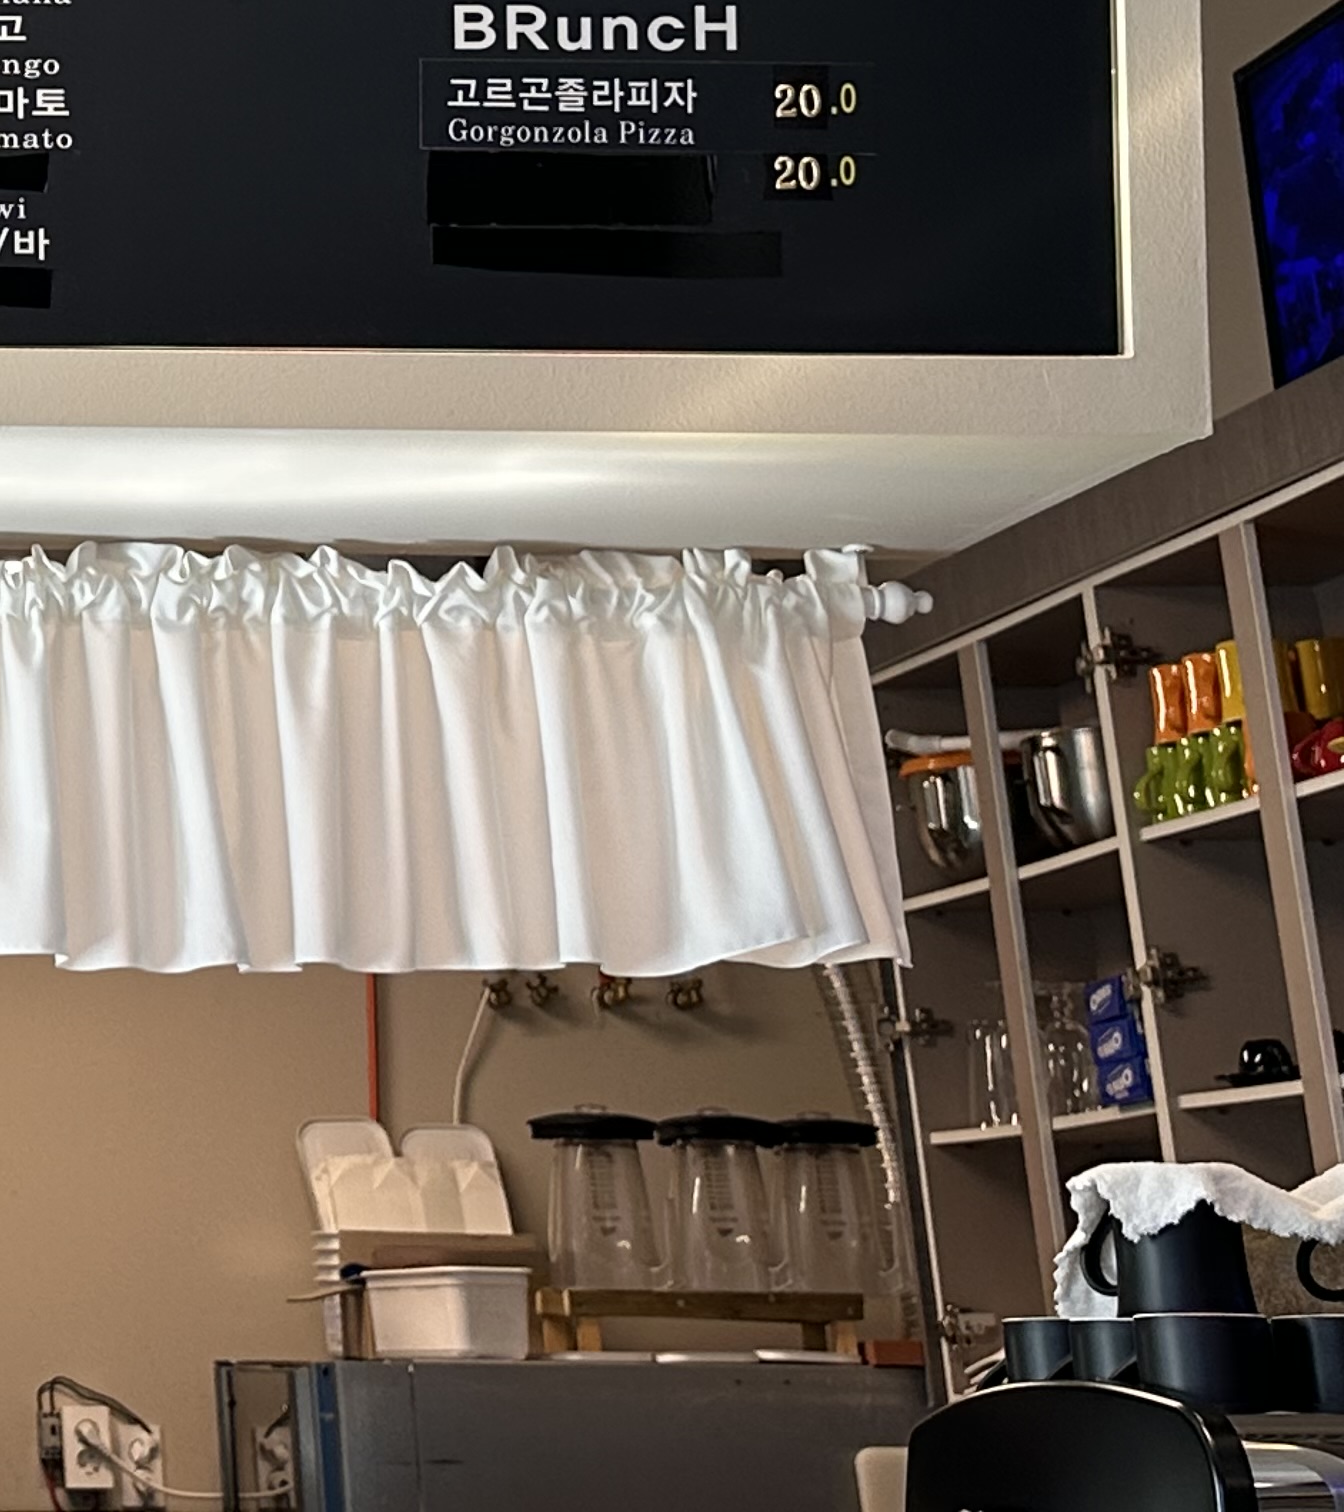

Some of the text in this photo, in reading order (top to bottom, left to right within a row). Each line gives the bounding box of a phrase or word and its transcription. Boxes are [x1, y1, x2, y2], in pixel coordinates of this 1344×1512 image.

[453, 4, 738, 52] BRuncH
[446, 77, 698, 114] 고르곤졸라피자
[448, 117, 695, 147] Gorgonzola Pizza
